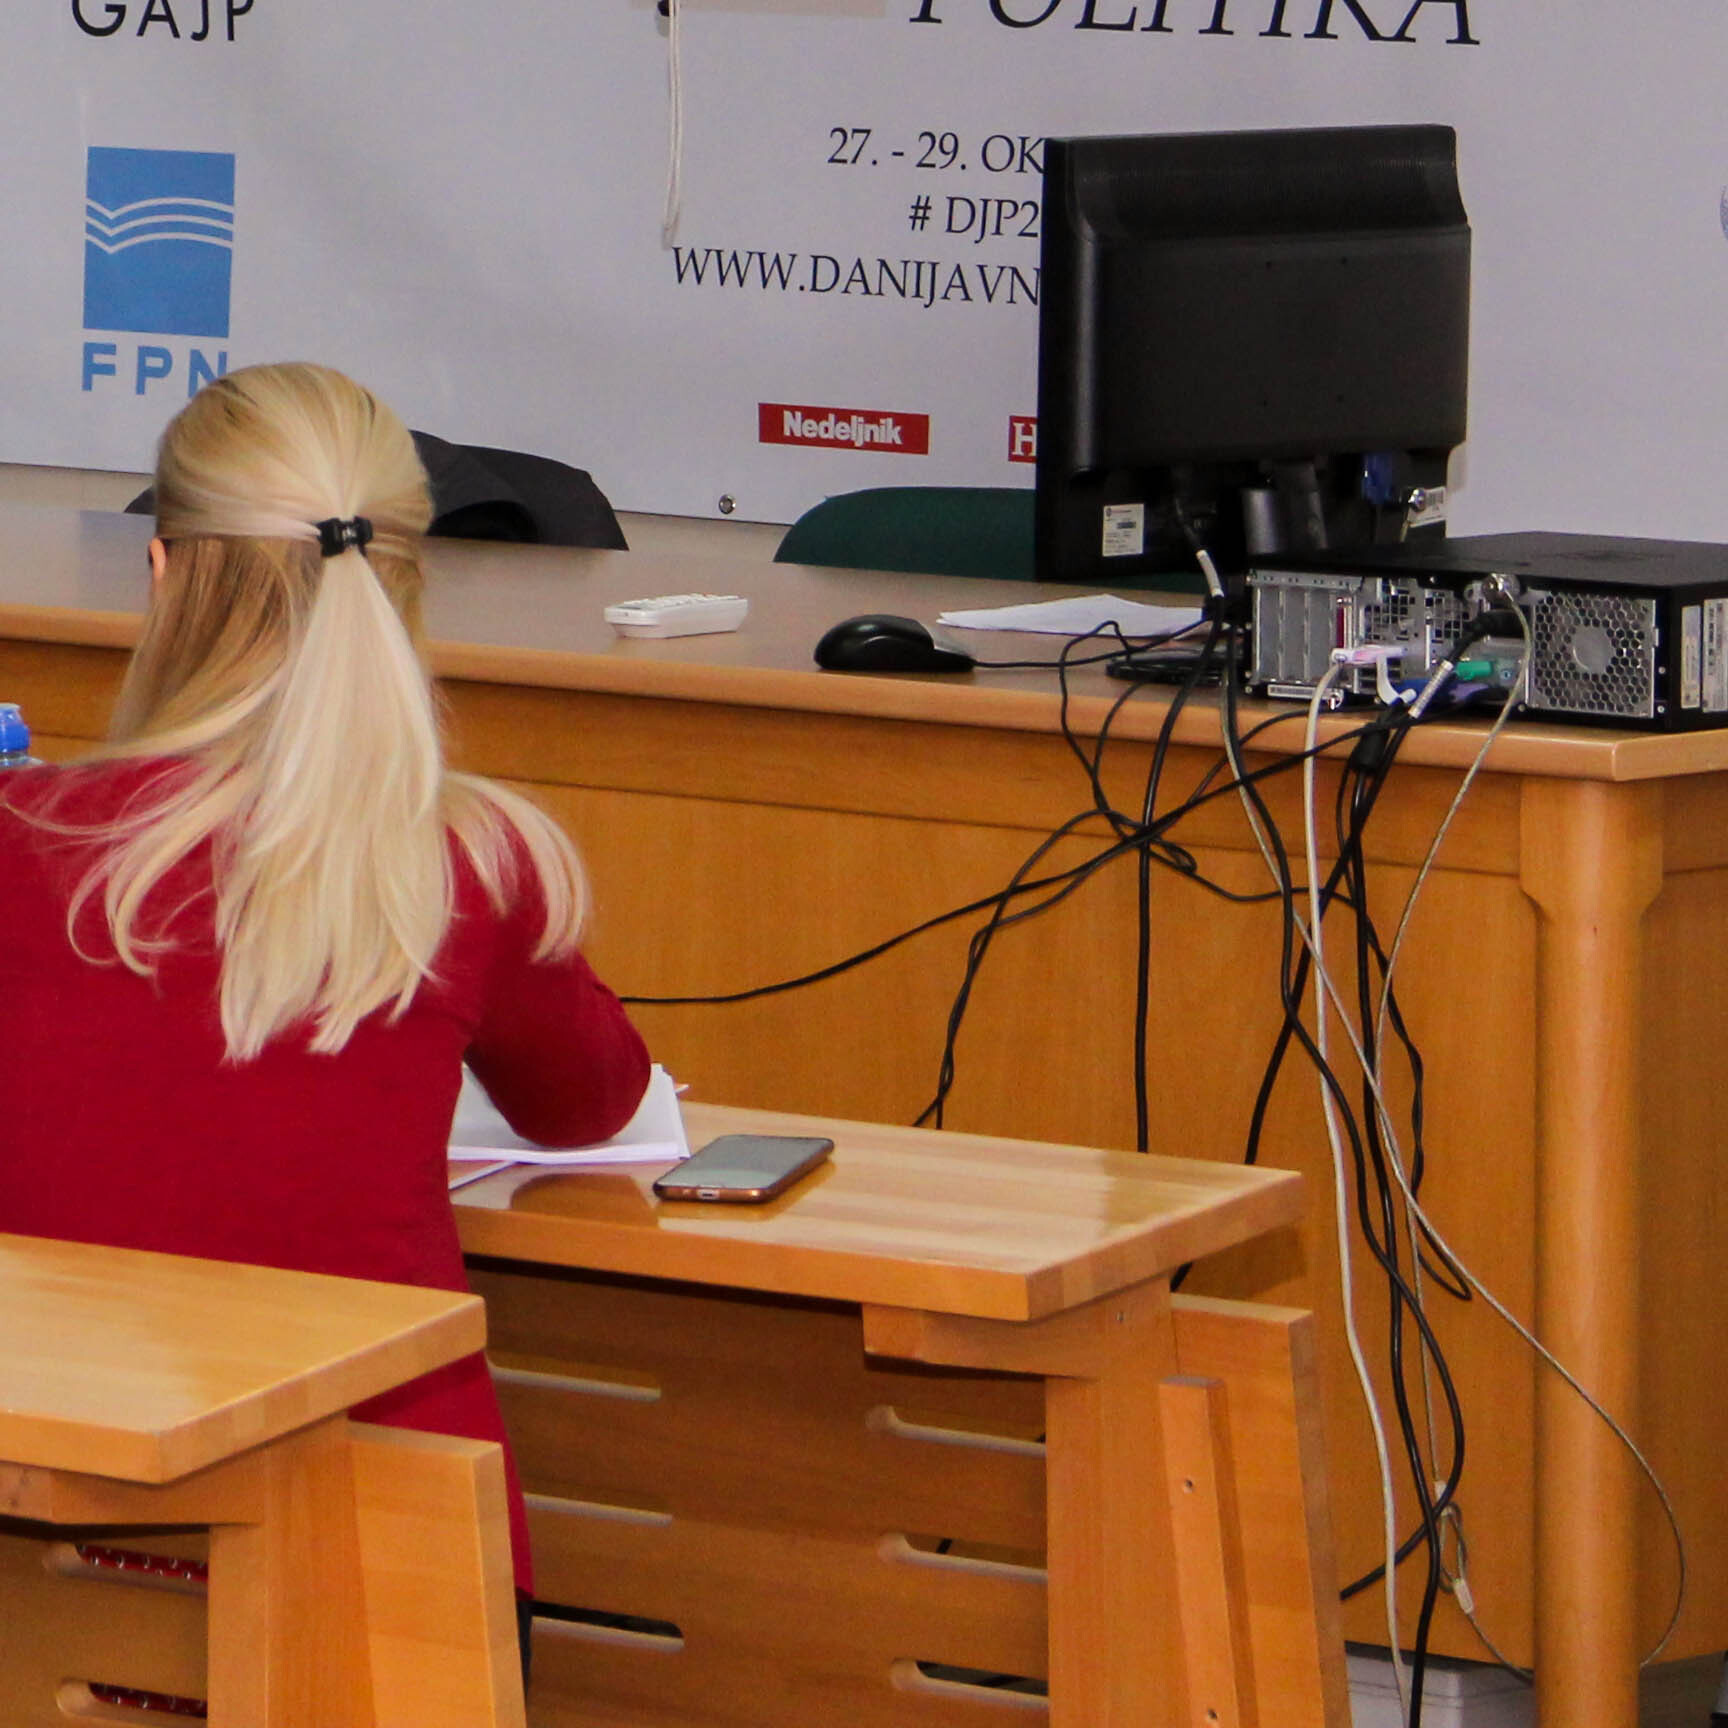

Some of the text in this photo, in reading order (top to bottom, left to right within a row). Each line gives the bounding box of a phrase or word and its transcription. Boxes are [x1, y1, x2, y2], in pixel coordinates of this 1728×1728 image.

[827, 127, 878, 167] 27.
[915, 132, 967, 171] 29.
[909, 195, 932, 232] #
[81, 342, 227, 398] FPN
[783, 410, 902, 447] Nedeljnik
